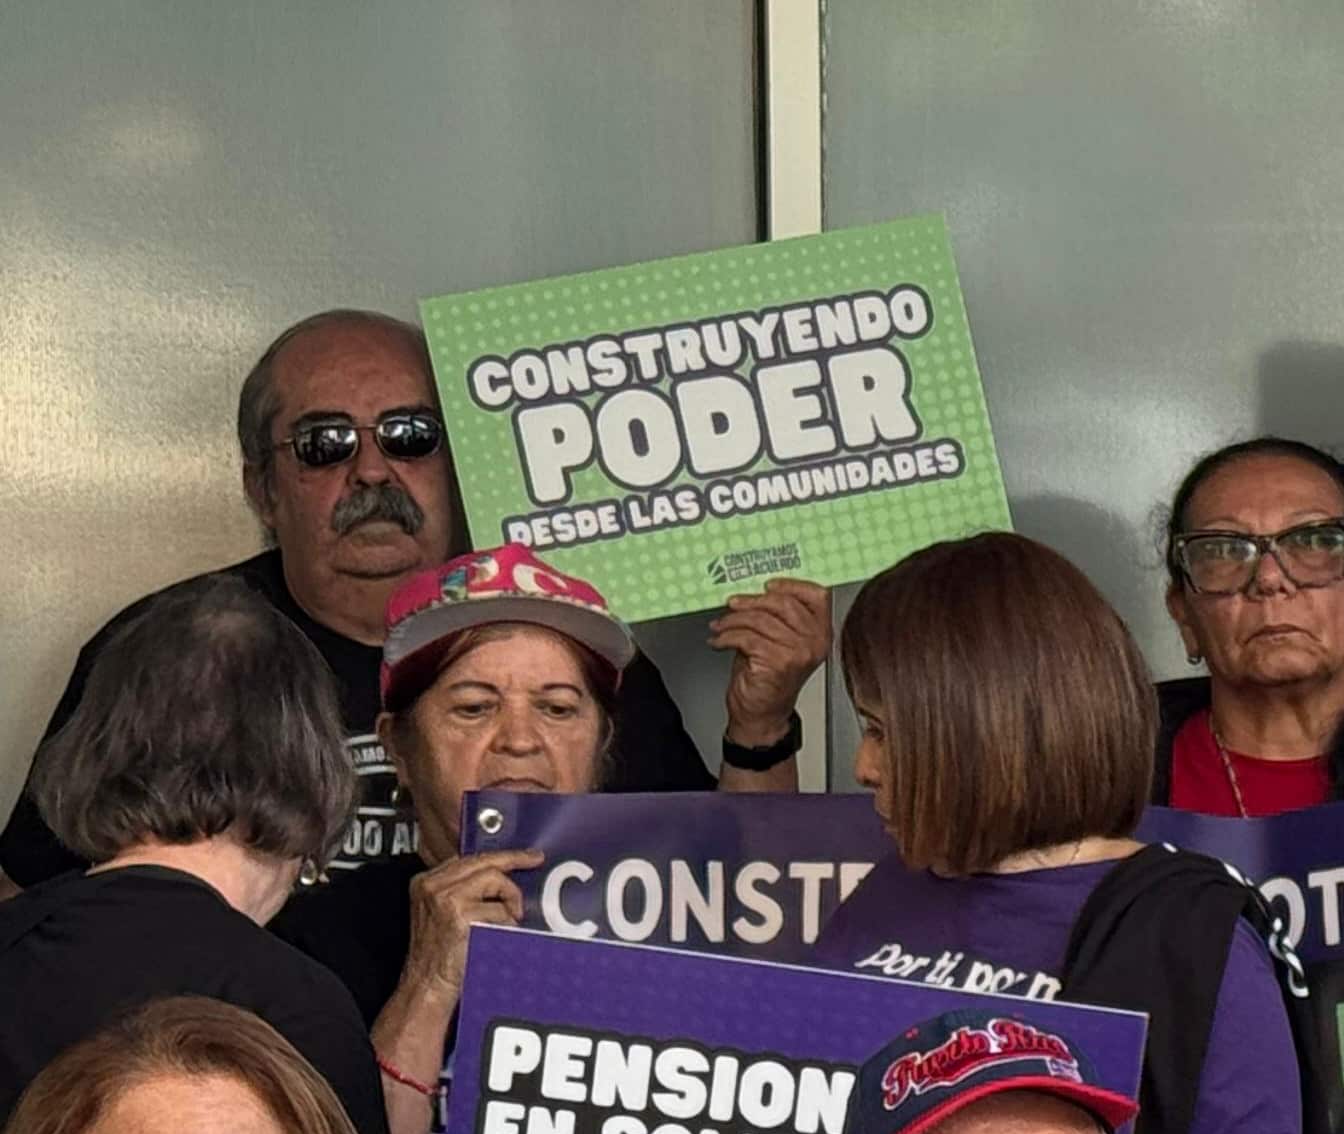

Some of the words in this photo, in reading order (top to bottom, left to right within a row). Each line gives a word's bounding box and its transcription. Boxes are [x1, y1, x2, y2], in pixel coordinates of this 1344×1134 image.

[473, 288, 927, 404] CONSTRUYENDO
[518, 347, 917, 503] PODER
[508, 508, 621, 548] DESDE
[631, 490, 699, 530] LAS
[710, 442, 959, 515] COMUNIDADES
[541, 858, 876, 944] CONST
